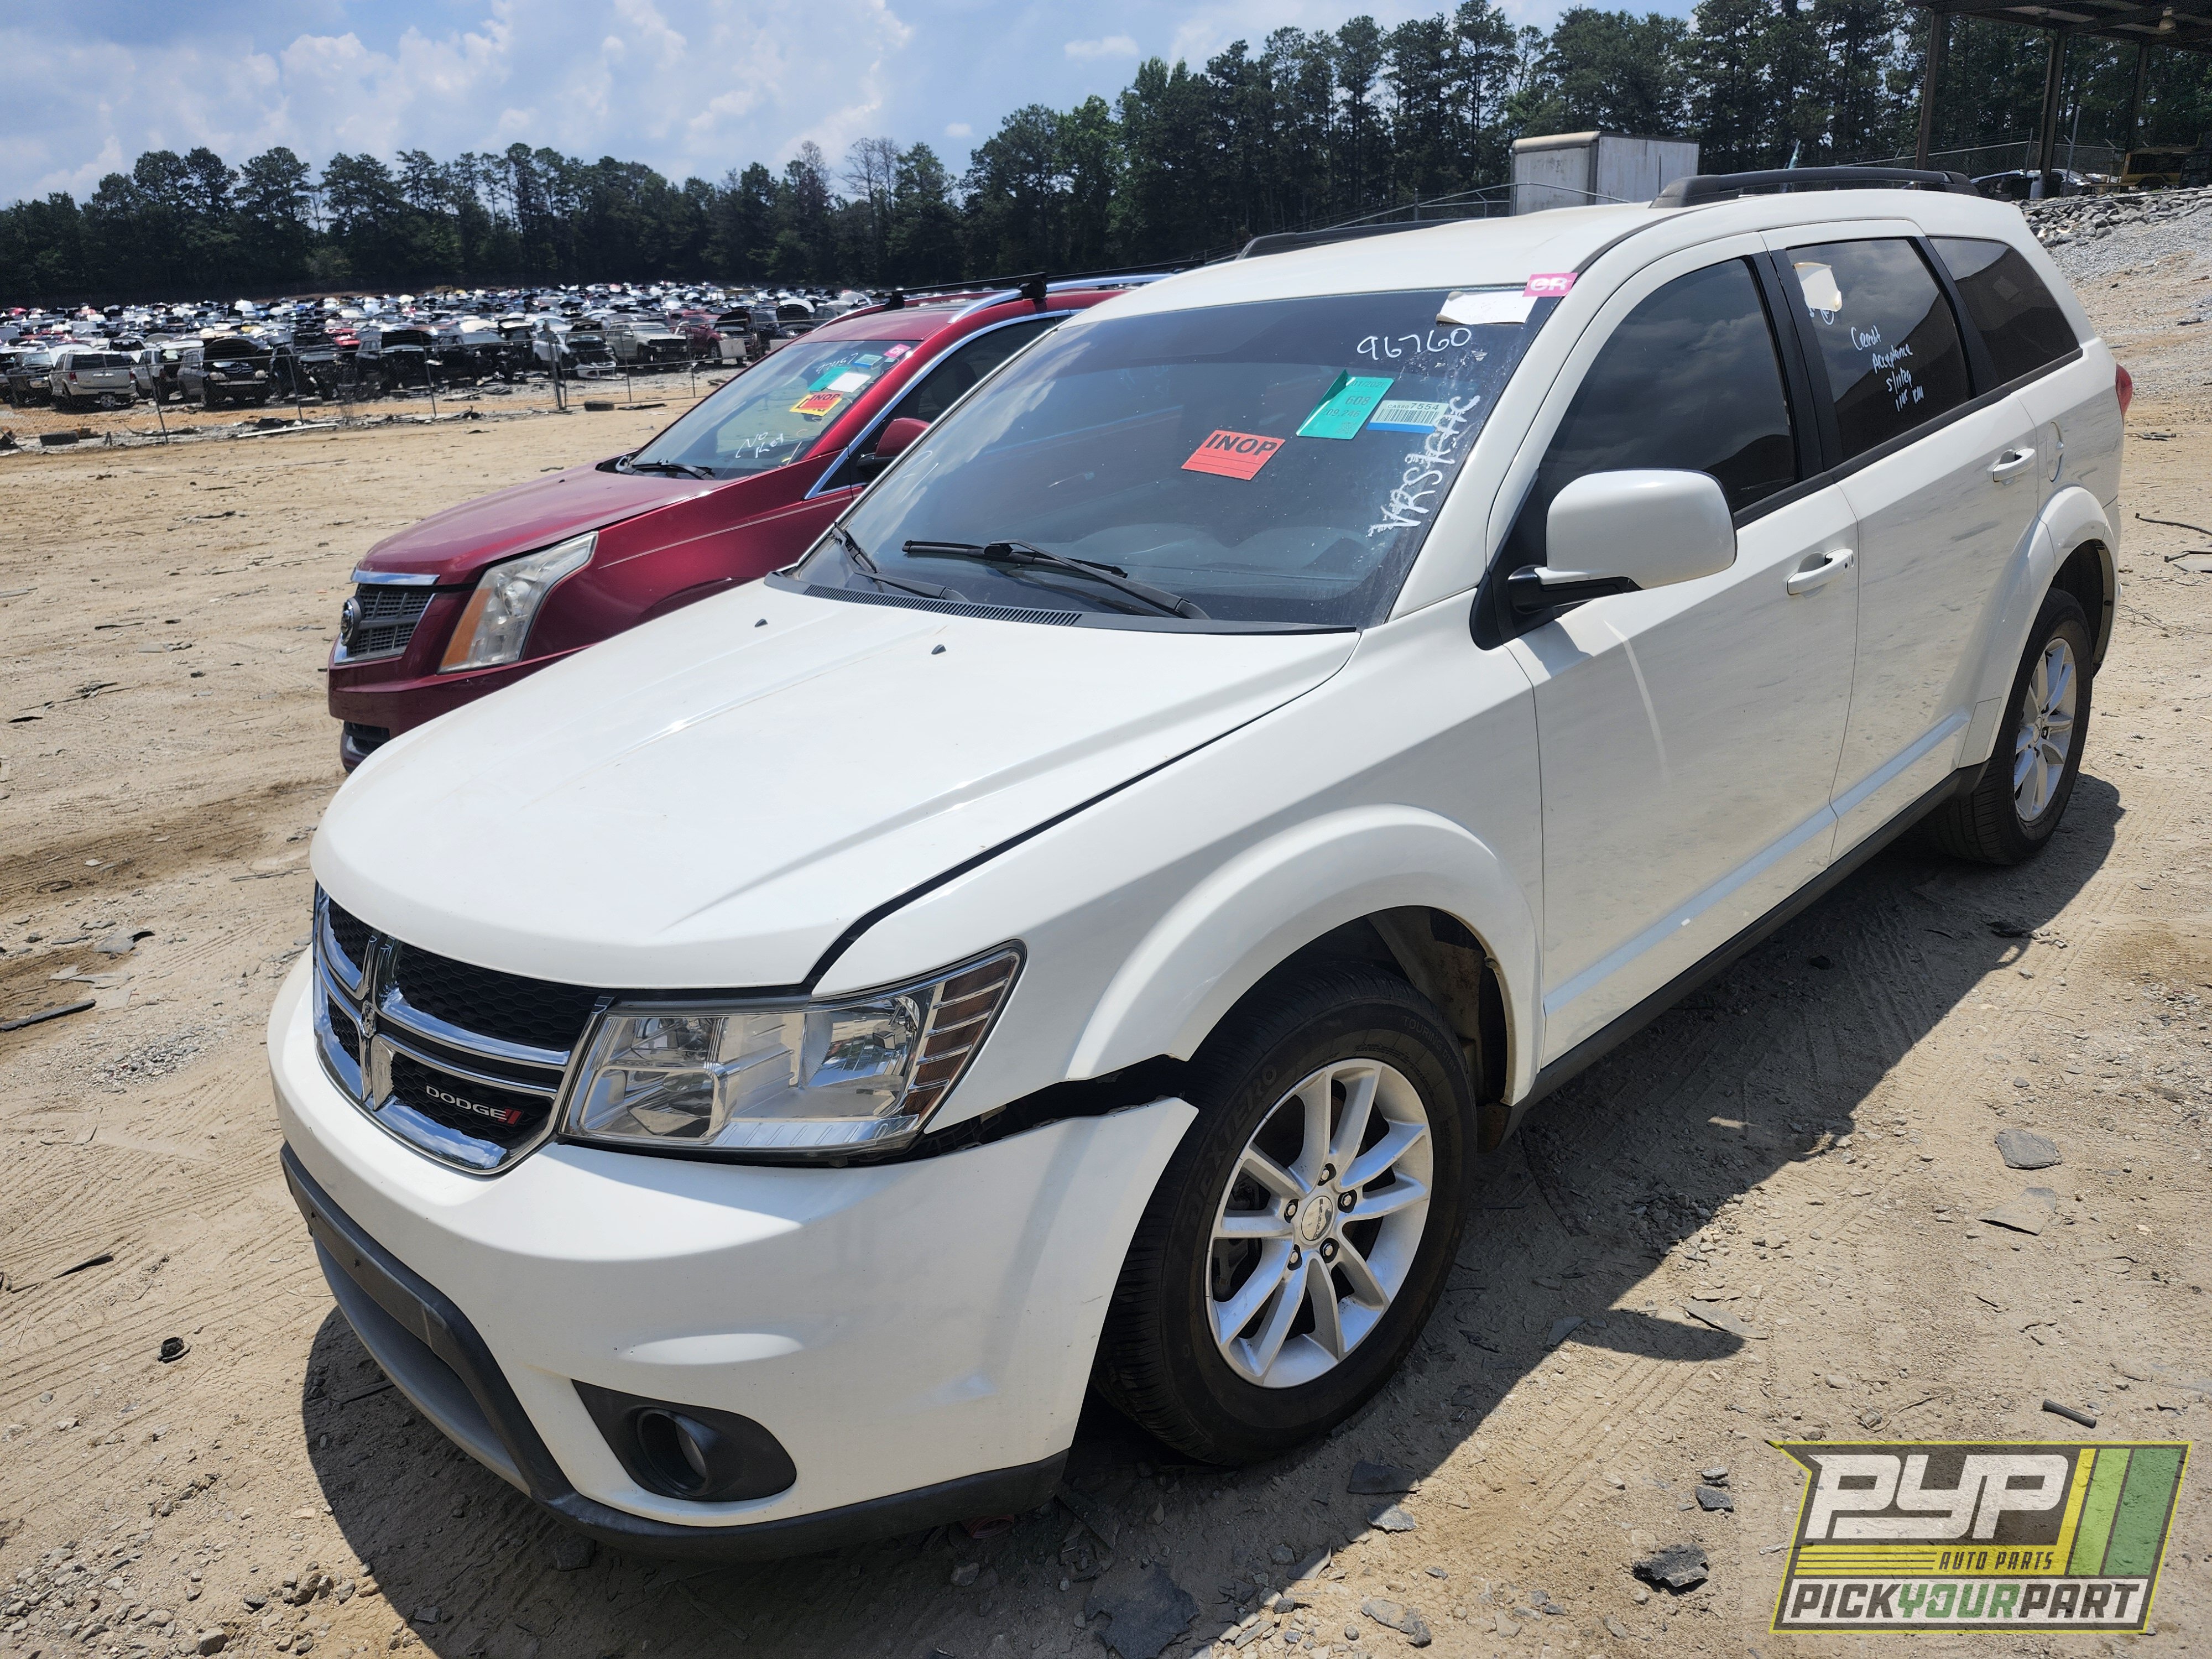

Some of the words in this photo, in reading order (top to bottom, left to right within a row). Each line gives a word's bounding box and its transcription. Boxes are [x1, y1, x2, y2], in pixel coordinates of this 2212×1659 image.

[1357, 327, 1472, 361] 96760
[1204, 434, 1277, 456] INOP
[425, 1084, 507, 1120] DODGE
